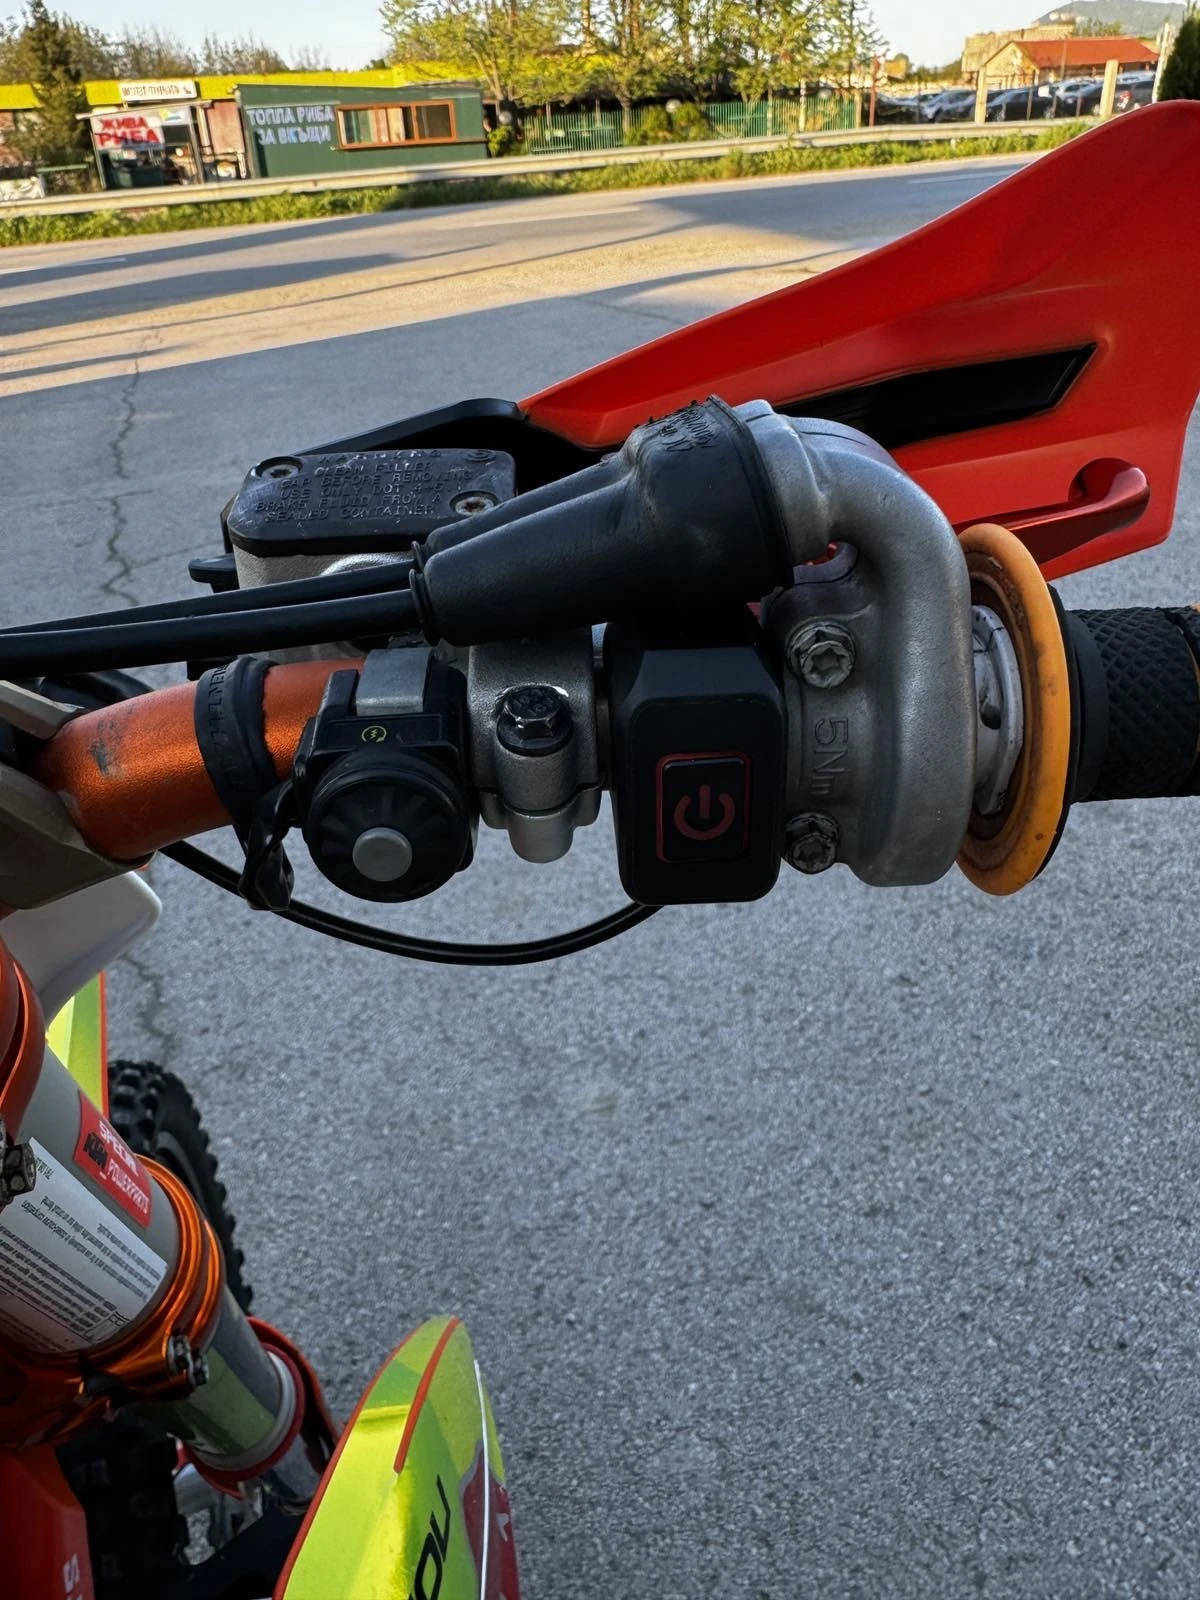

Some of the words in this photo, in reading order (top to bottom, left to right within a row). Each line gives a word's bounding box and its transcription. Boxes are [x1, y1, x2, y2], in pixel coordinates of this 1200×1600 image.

[99, 116, 147, 131] ЖИВА
[246, 107, 296, 125] ТОПЛА
[296, 104, 335, 123] РИБА
[95, 128, 160, 146] РИБА
[257, 127, 277, 145] ЗА
[314, 463, 365, 476] CLEAN
[375, 461, 434, 473] FILLER
[321, 473, 382, 487] BEFORE
[391, 471, 473, 484] REMOVING
[280, 488, 312, 500] USE
[320, 485, 362, 497] ONLY
[373, 483, 404, 496] DOT
[256, 501, 307, 513] BRAKE
[319, 496, 370, 509] FLUID
[383, 494, 423, 506] FROM
[431, 493, 441, 504] A
[812, 717, 849, 794] 5Nm
